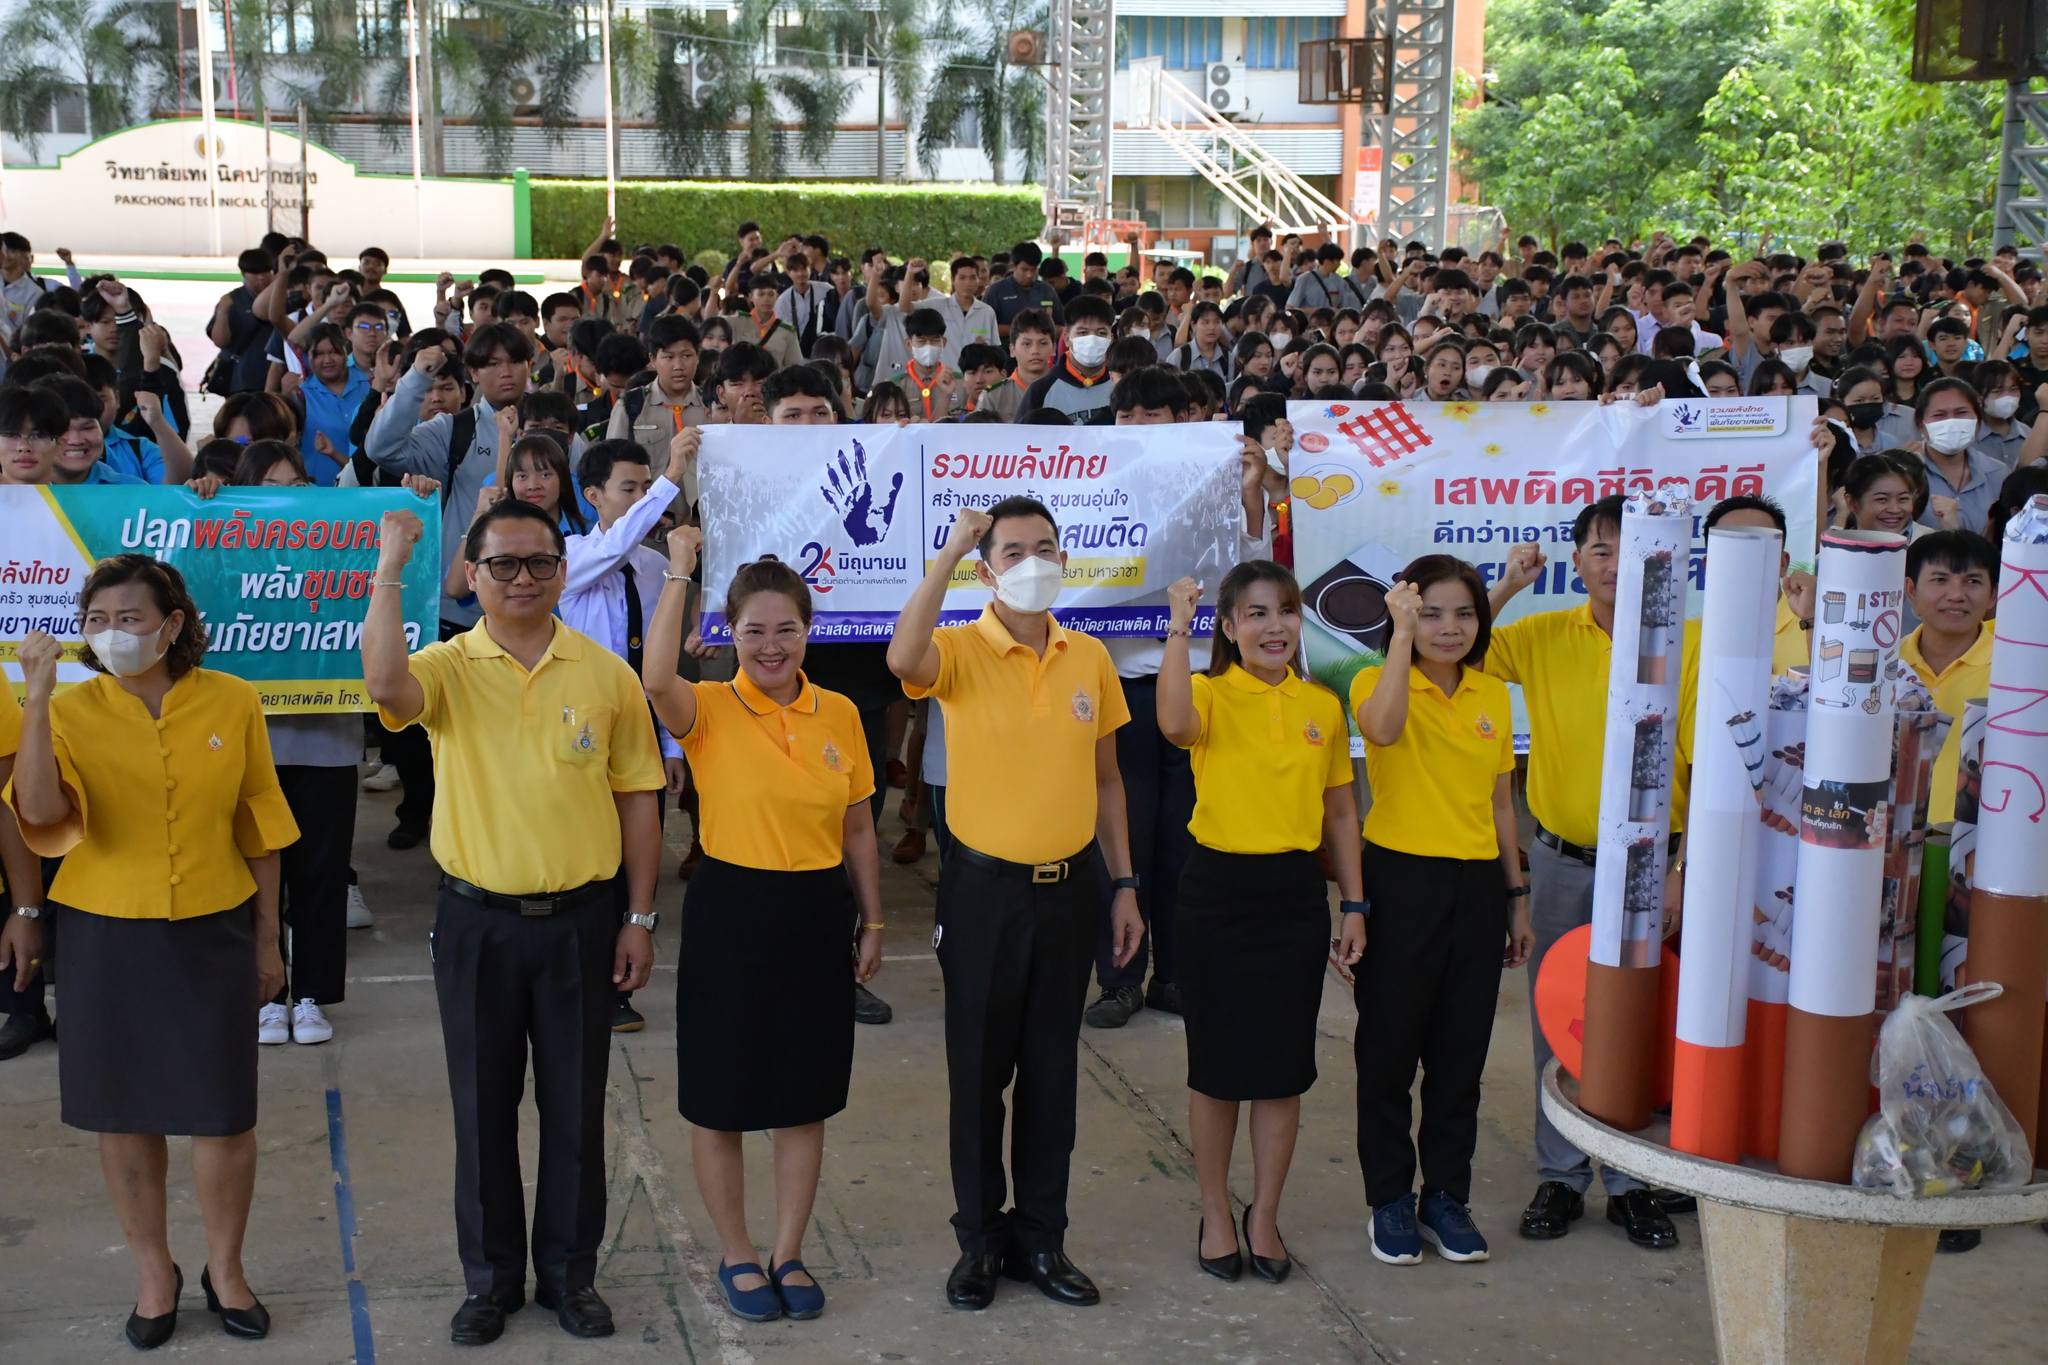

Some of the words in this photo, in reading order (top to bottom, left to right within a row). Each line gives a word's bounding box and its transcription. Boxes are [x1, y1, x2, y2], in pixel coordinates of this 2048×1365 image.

[114, 193, 186, 207] PAKCHONG
[189, 194, 258, 209] TECNICAL
[931, 445, 1108, 480] รวมพลังไทย
[1050, 488, 1129, 513] ชุมชนอุ่นใจ
[0, 559, 71, 585] ลังไทย
[838, 552, 907, 575] มิถุนายน
[1088, 566, 1139, 578] มหาราชา
[28, 591, 80, 609] ชุมชนอุ่น
